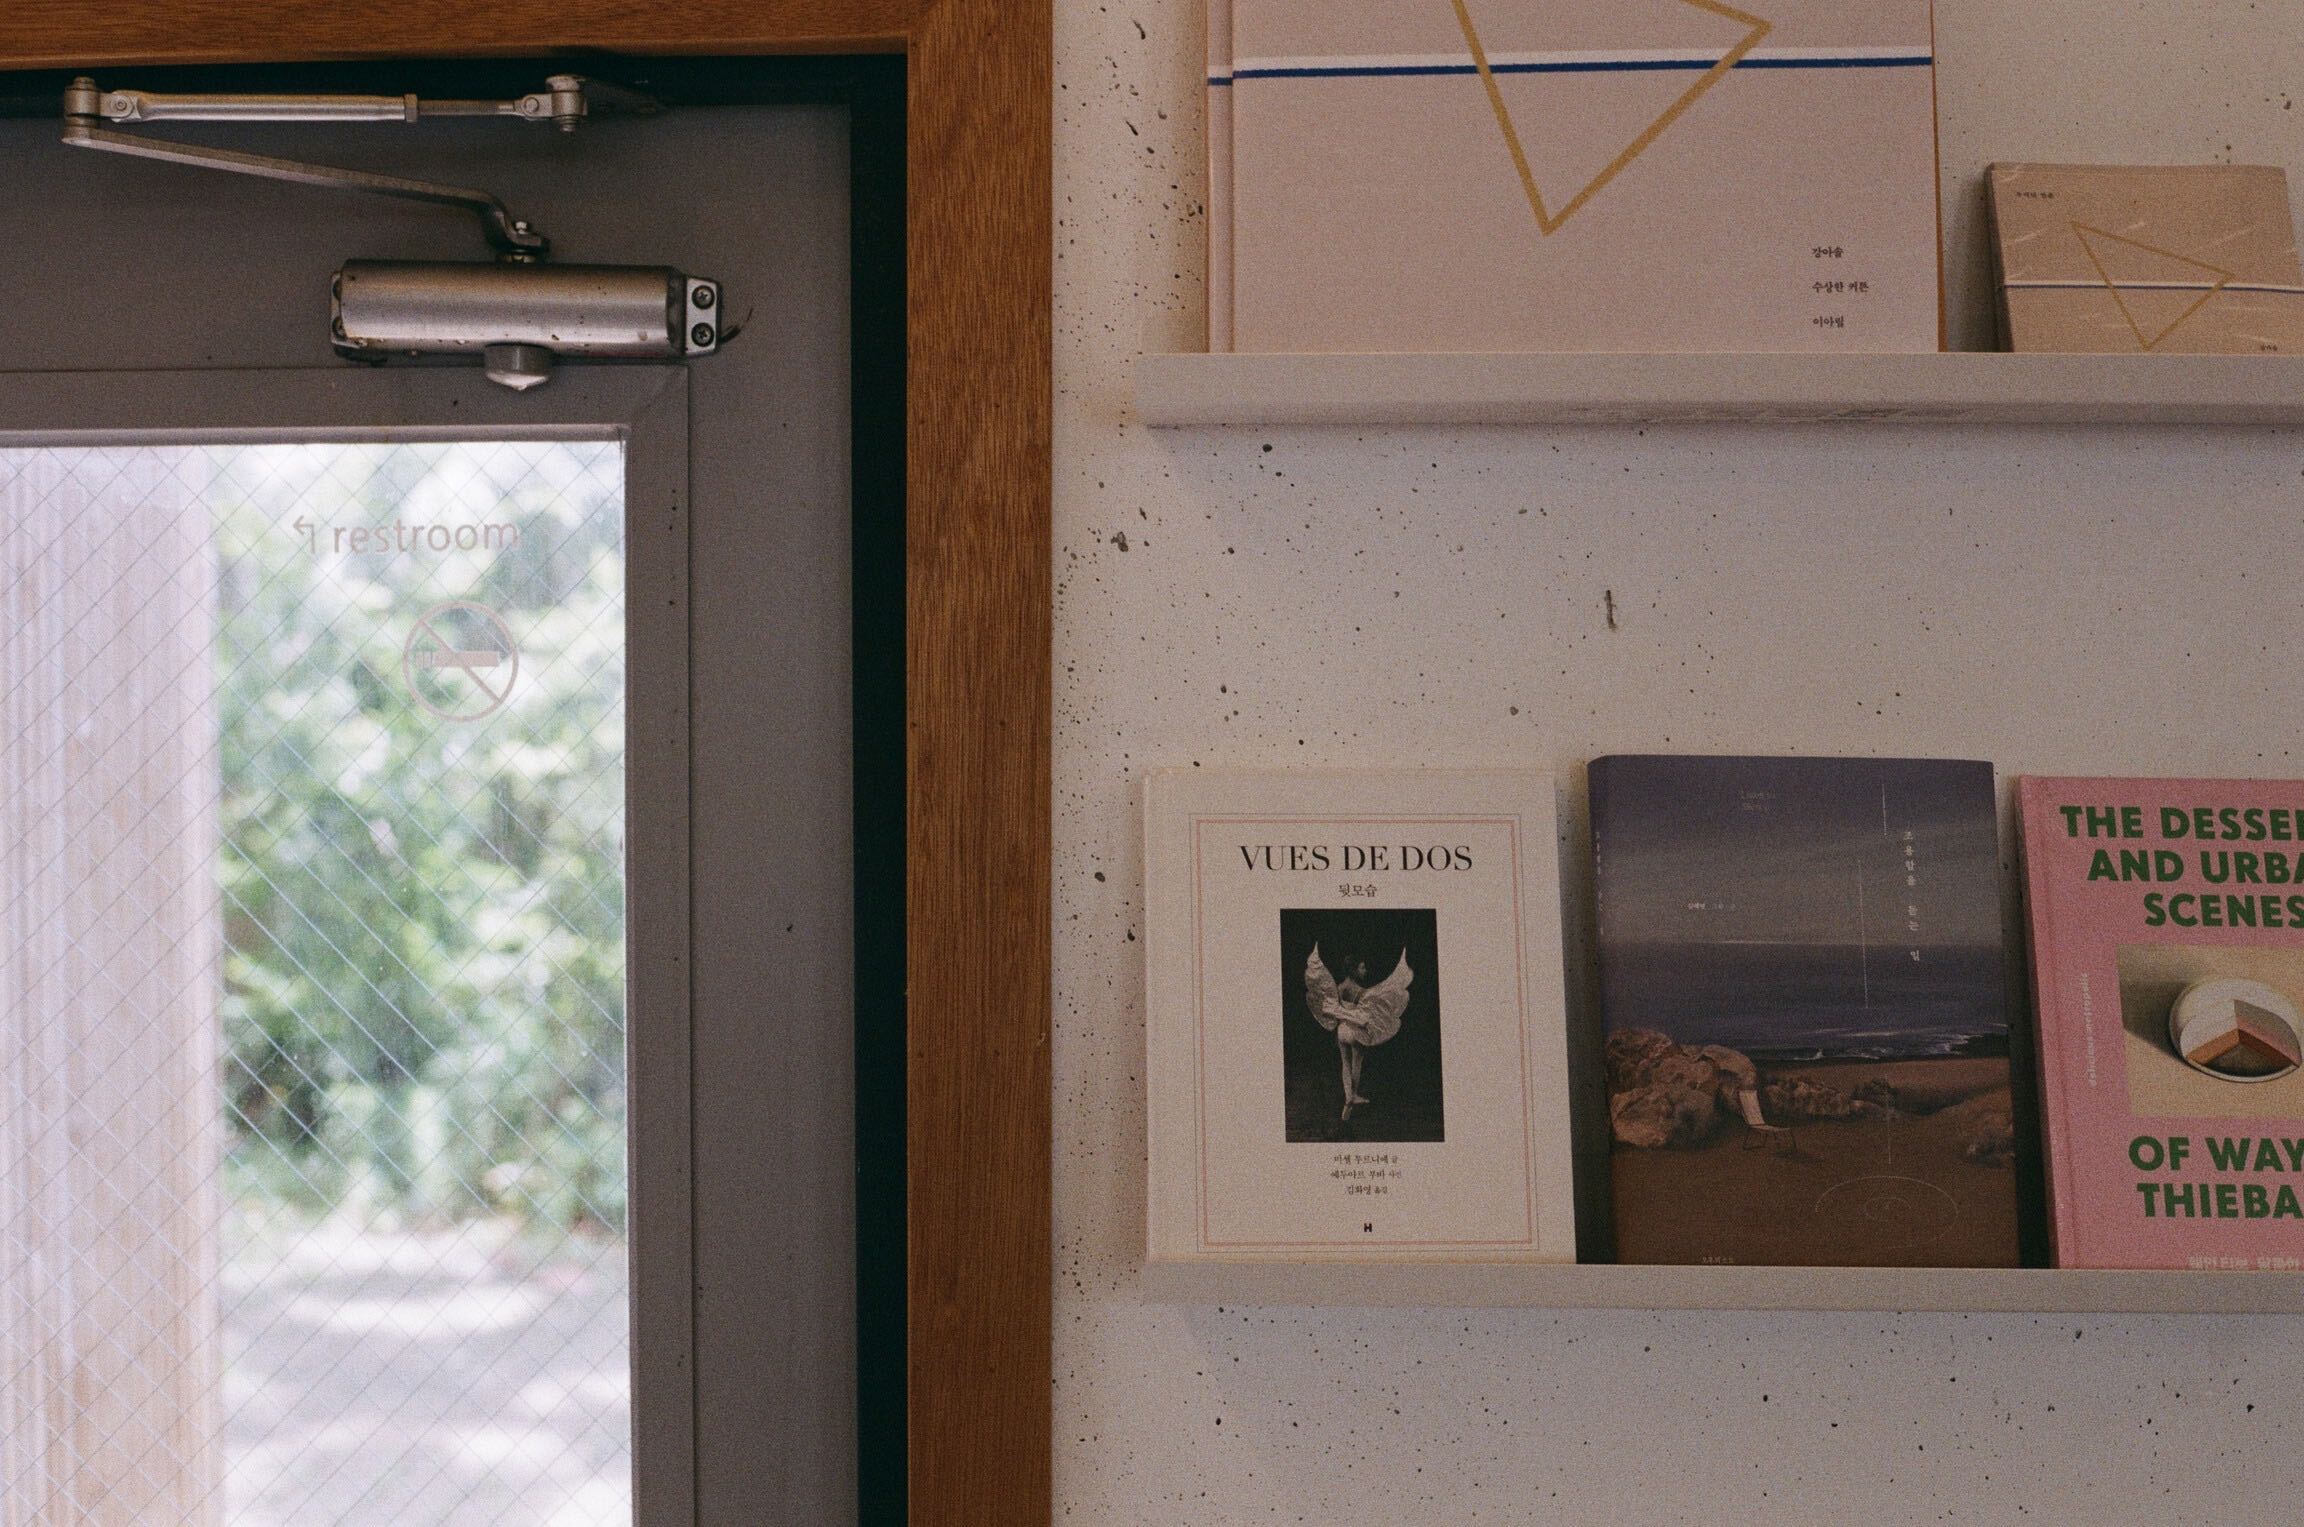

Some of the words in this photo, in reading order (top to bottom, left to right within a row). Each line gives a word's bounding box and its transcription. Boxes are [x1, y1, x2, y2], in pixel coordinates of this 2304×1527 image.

[1812, 281, 1844, 294] 수상한
[333, 518, 519, 553] restroom
[2059, 805, 2144, 839] THE
[1238, 845, 1330, 871] VUES
[1342, 845, 1389, 871] DE
[1400, 845, 1473, 871] DOS
[2087, 849, 2184, 882] AND
[1338, 883, 1378, 897] 뒷모습
[2143, 893, 2304, 928] SCENES
[2128, 1135, 2190, 1171] OF
[2205, 1137, 2304, 1172] WAY
[2137, 1183, 2304, 1218] THIEBA
[1363, 1223, 1373, 1233] H
